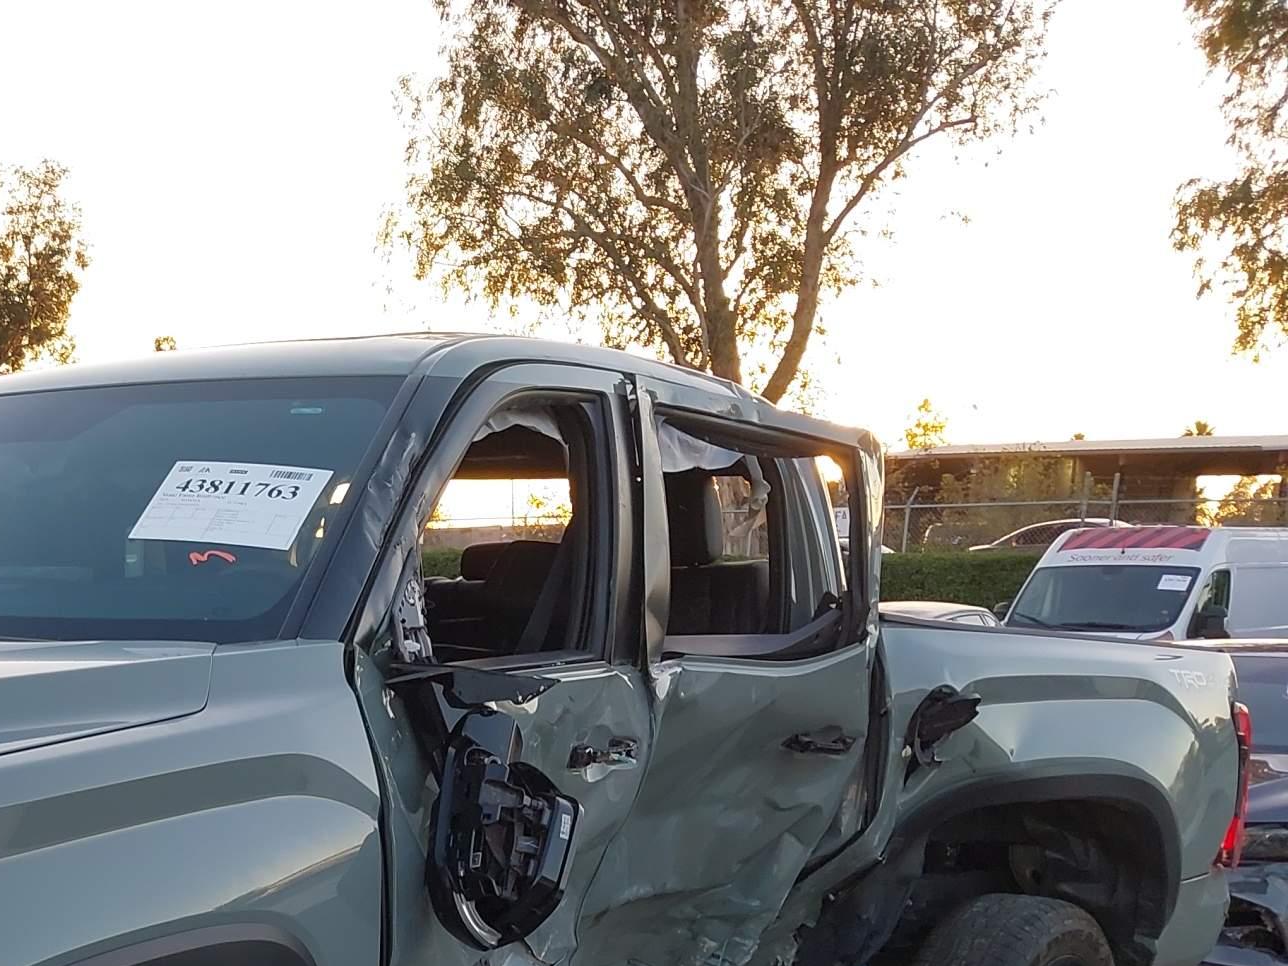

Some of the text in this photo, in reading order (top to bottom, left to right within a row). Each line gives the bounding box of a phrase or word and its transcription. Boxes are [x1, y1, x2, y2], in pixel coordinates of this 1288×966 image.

[175, 478, 301, 501] 43811763
[1067, 553, 1111, 562] Sooner
[1142, 553, 1175, 563] safer
